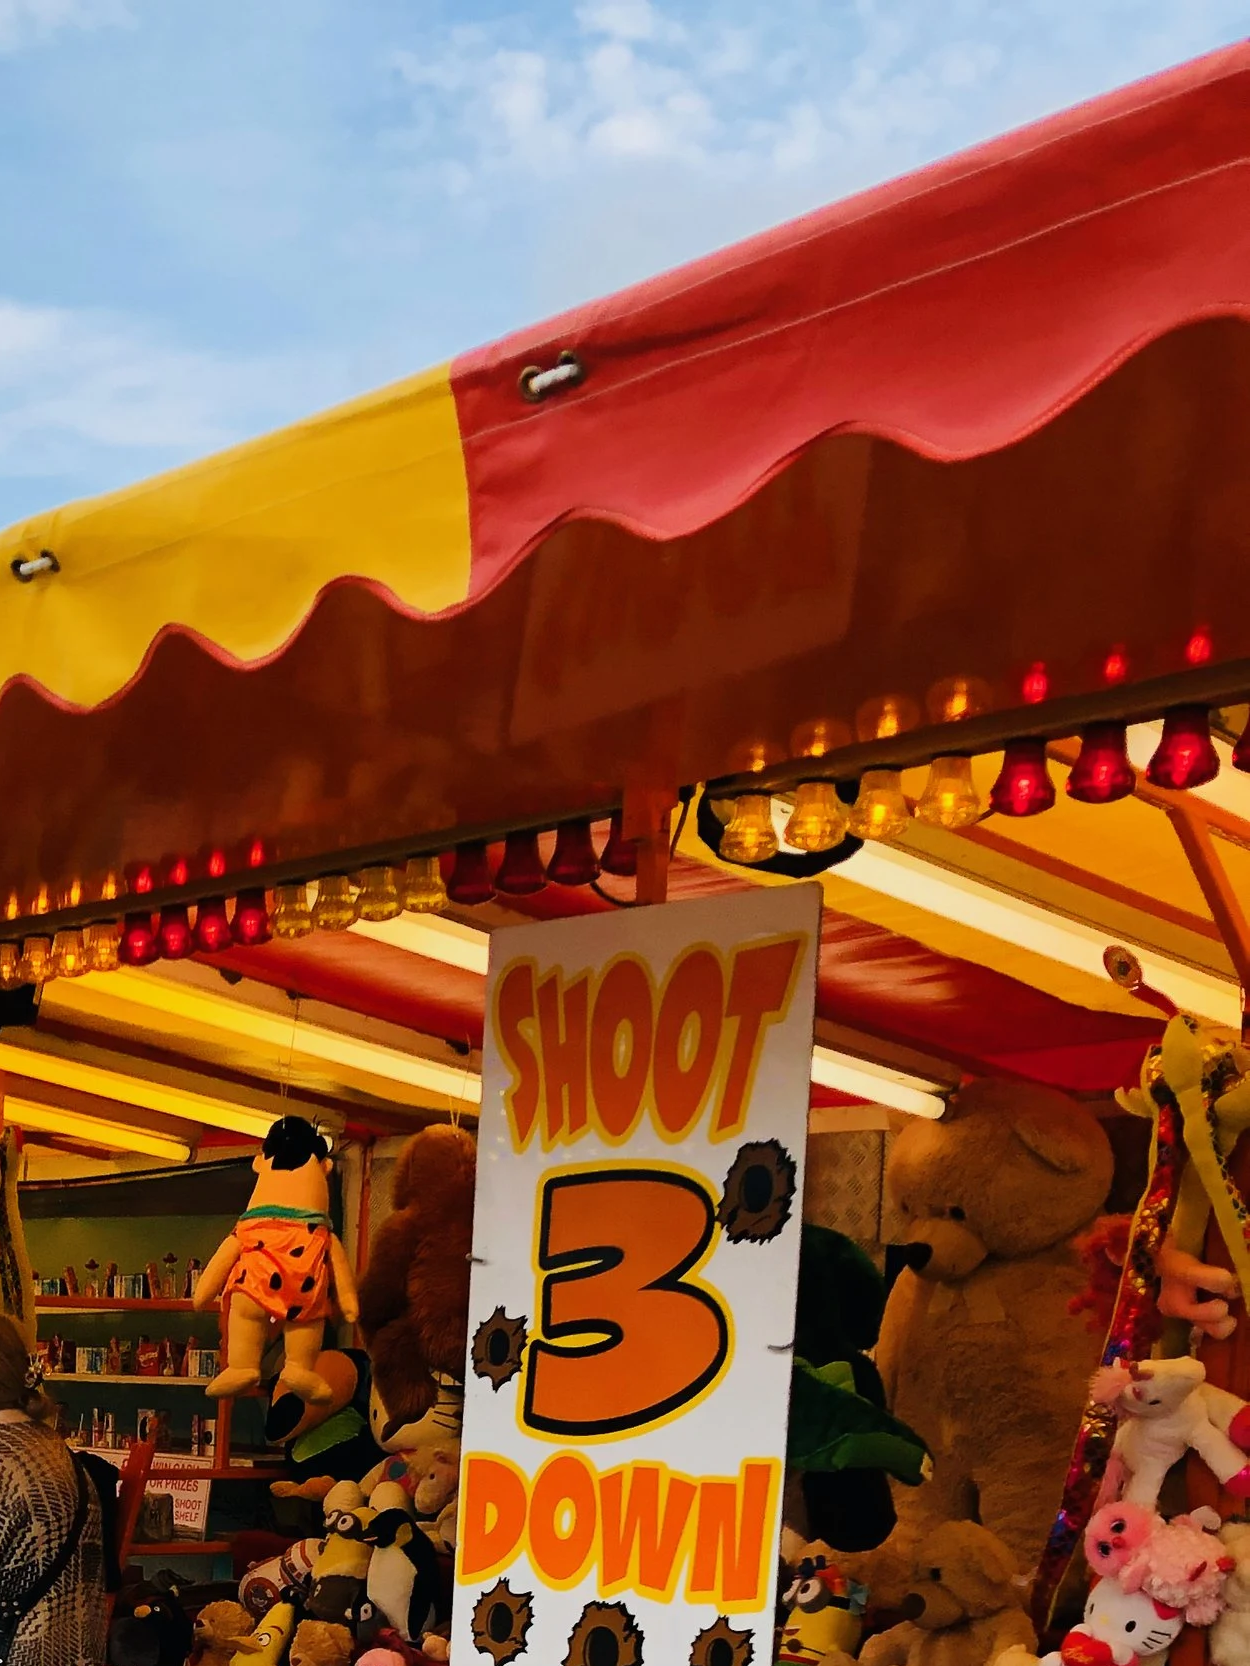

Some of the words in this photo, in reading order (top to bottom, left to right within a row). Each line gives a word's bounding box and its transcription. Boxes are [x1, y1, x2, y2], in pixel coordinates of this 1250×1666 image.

[493, 933, 807, 1154] SHOOT
[518, 1159, 735, 1443] 3
[166, 1480, 198, 1492] PRIZES
[174, 1498, 202, 1511] SHOOT
[174, 1511, 200, 1522] SHELF
[457, 1449, 781, 1613] DOWN
